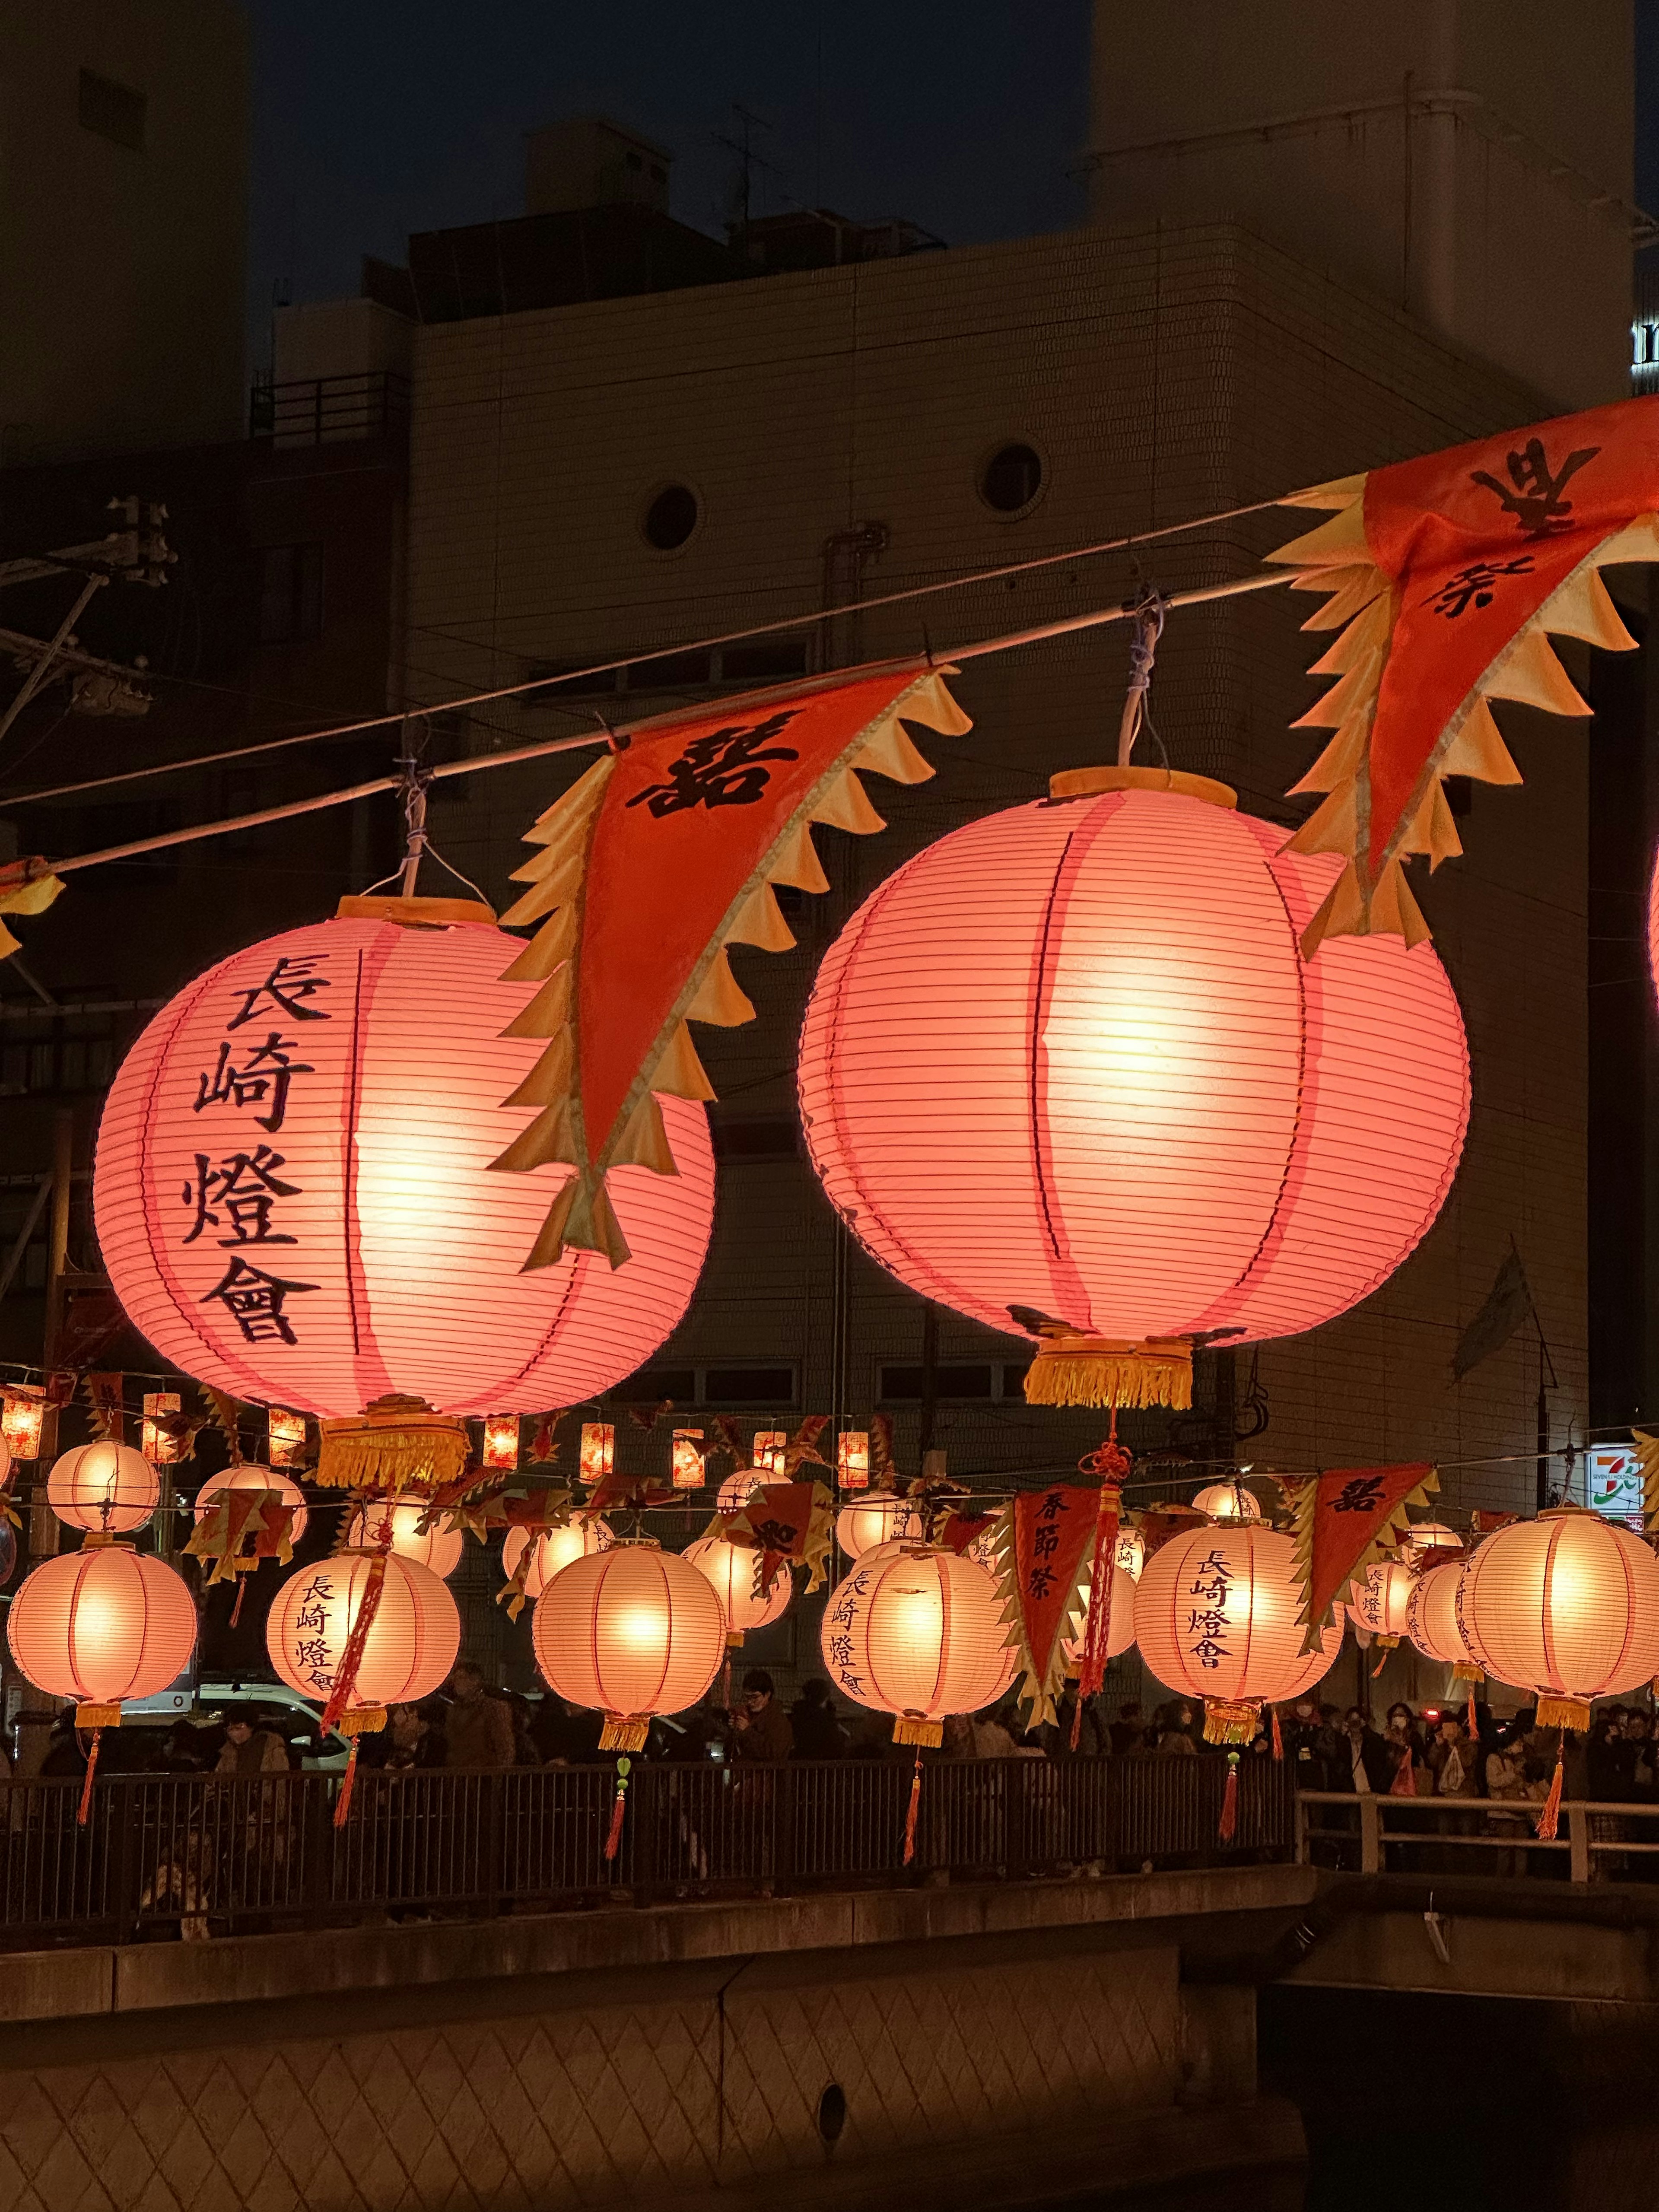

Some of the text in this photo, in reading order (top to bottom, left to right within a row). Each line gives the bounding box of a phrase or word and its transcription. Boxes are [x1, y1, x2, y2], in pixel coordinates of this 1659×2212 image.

[181, 953, 332, 1345] 長崎燈會
[295, 1575, 336, 1692] 長崎燈會
[830, 1570, 872, 1697] 長崎燈會
[1188, 1550, 1233, 1669] 長崎燈會
[1362, 1569, 1384, 1624] 長崎燈會
